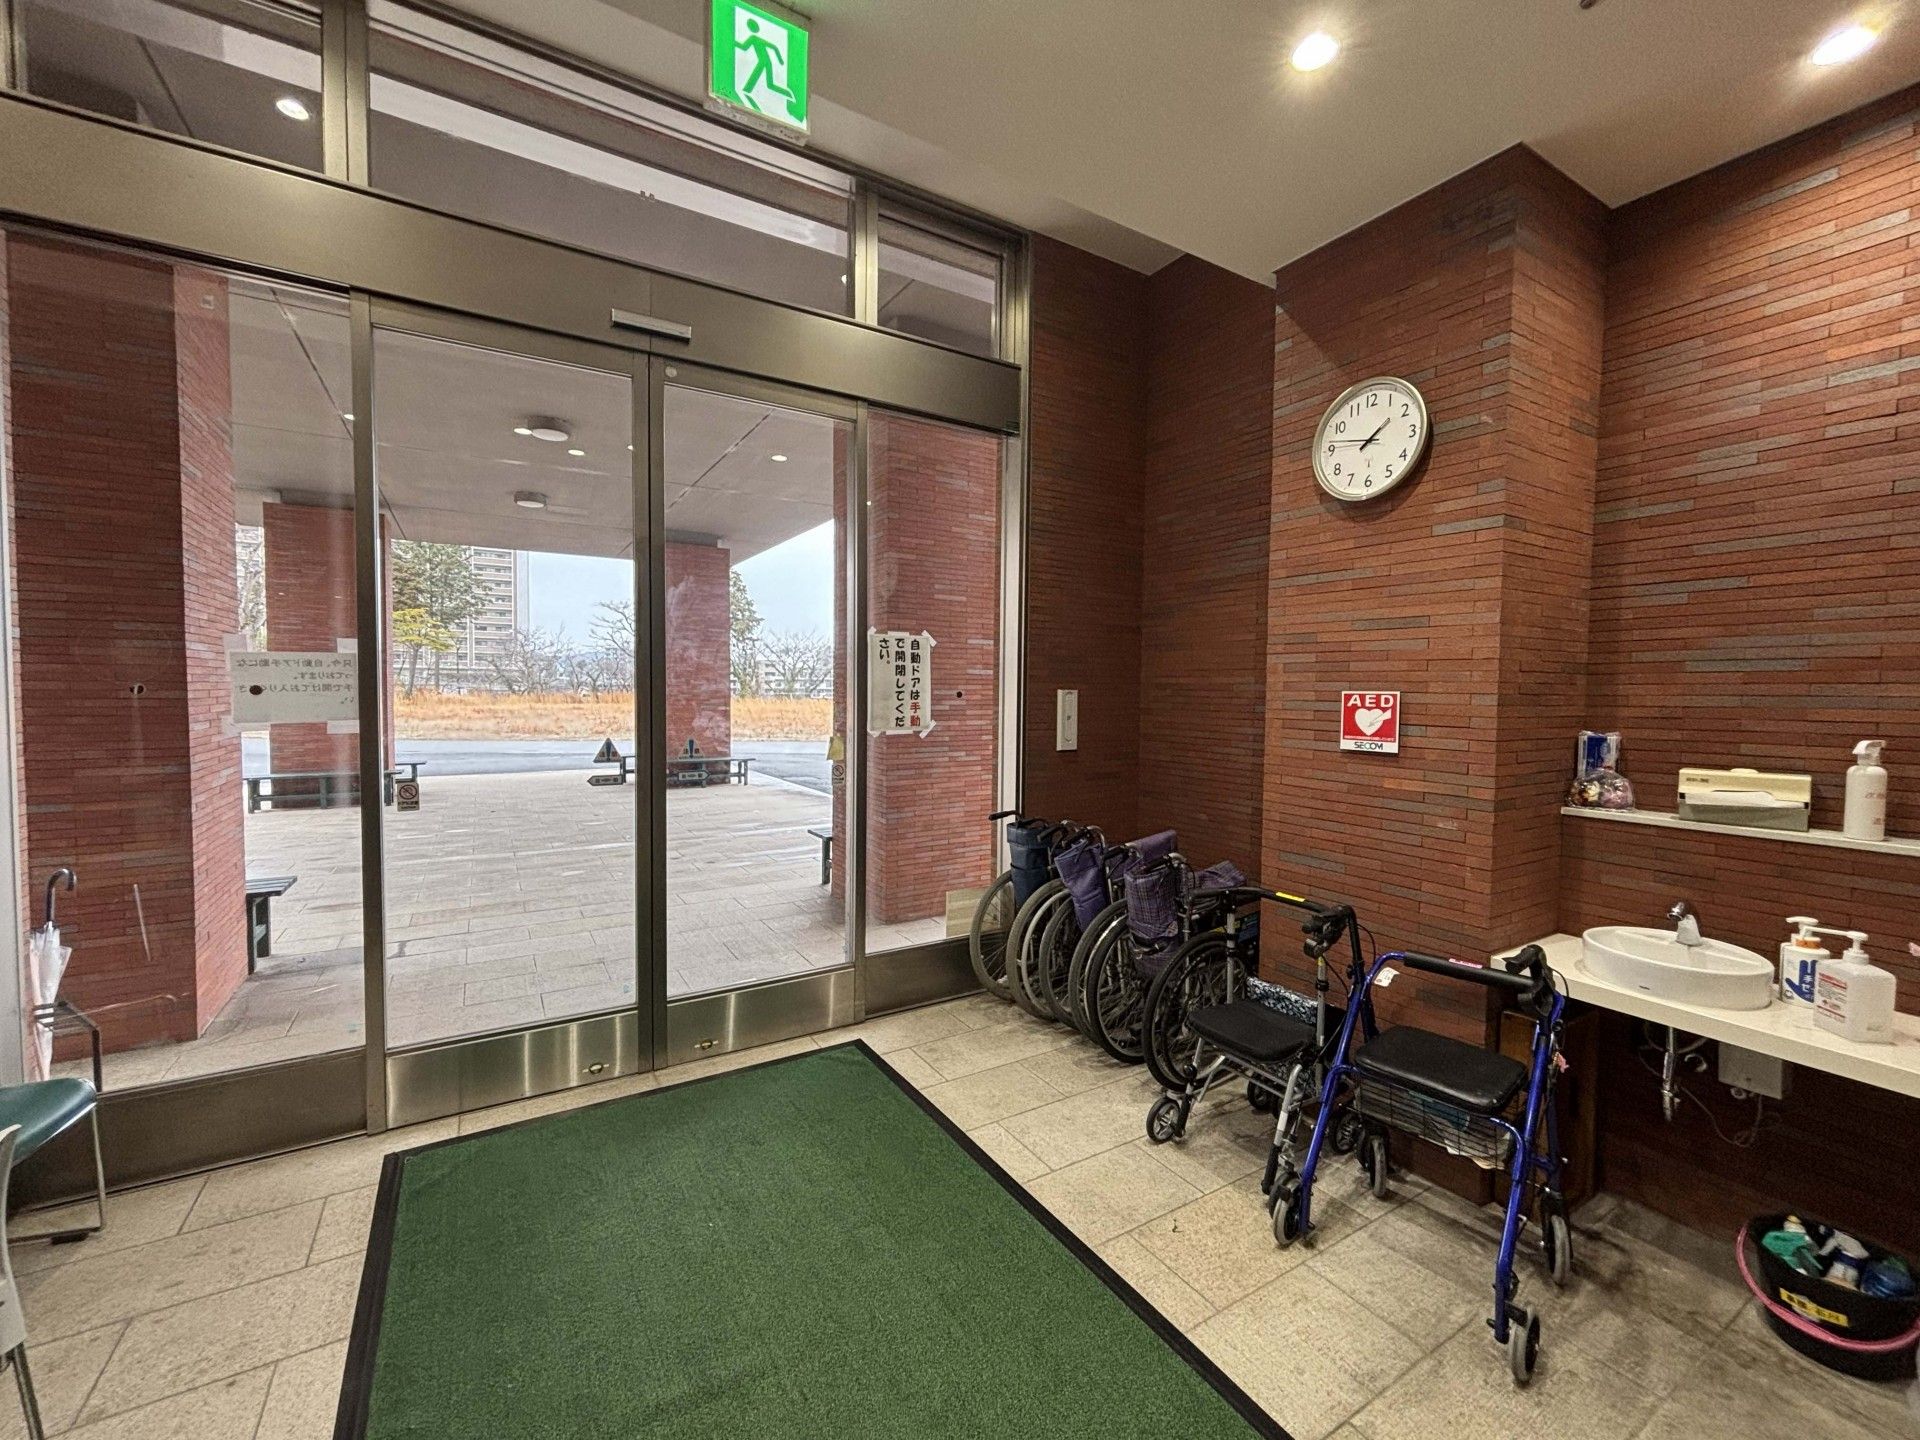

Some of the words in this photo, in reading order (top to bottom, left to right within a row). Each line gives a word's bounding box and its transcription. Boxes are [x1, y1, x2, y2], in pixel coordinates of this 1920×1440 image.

[1366, 393, 1378, 408] 12
[1350, 403, 1360, 417] 11
[1401, 403, 1410, 418] 2
[1335, 421, 1346, 434] 10
[1409, 424, 1417, 438] 3
[1328, 444, 1336, 457] 9
[1399, 447, 1408, 461] 4
[1333, 463, 1342, 476] 8
[1385, 464, 1393, 478] 5
[1347, 473, 1355, 486] 7
[1364, 474, 1373, 487] 6
[879, 638, 890, 664] さい。
[895, 638, 906, 727] で開閉してくだ
[910, 639, 921, 727] 自動ドアは手動
[1347, 694, 1394, 707] AED
[1354, 741, 1384, 751] SECOM
